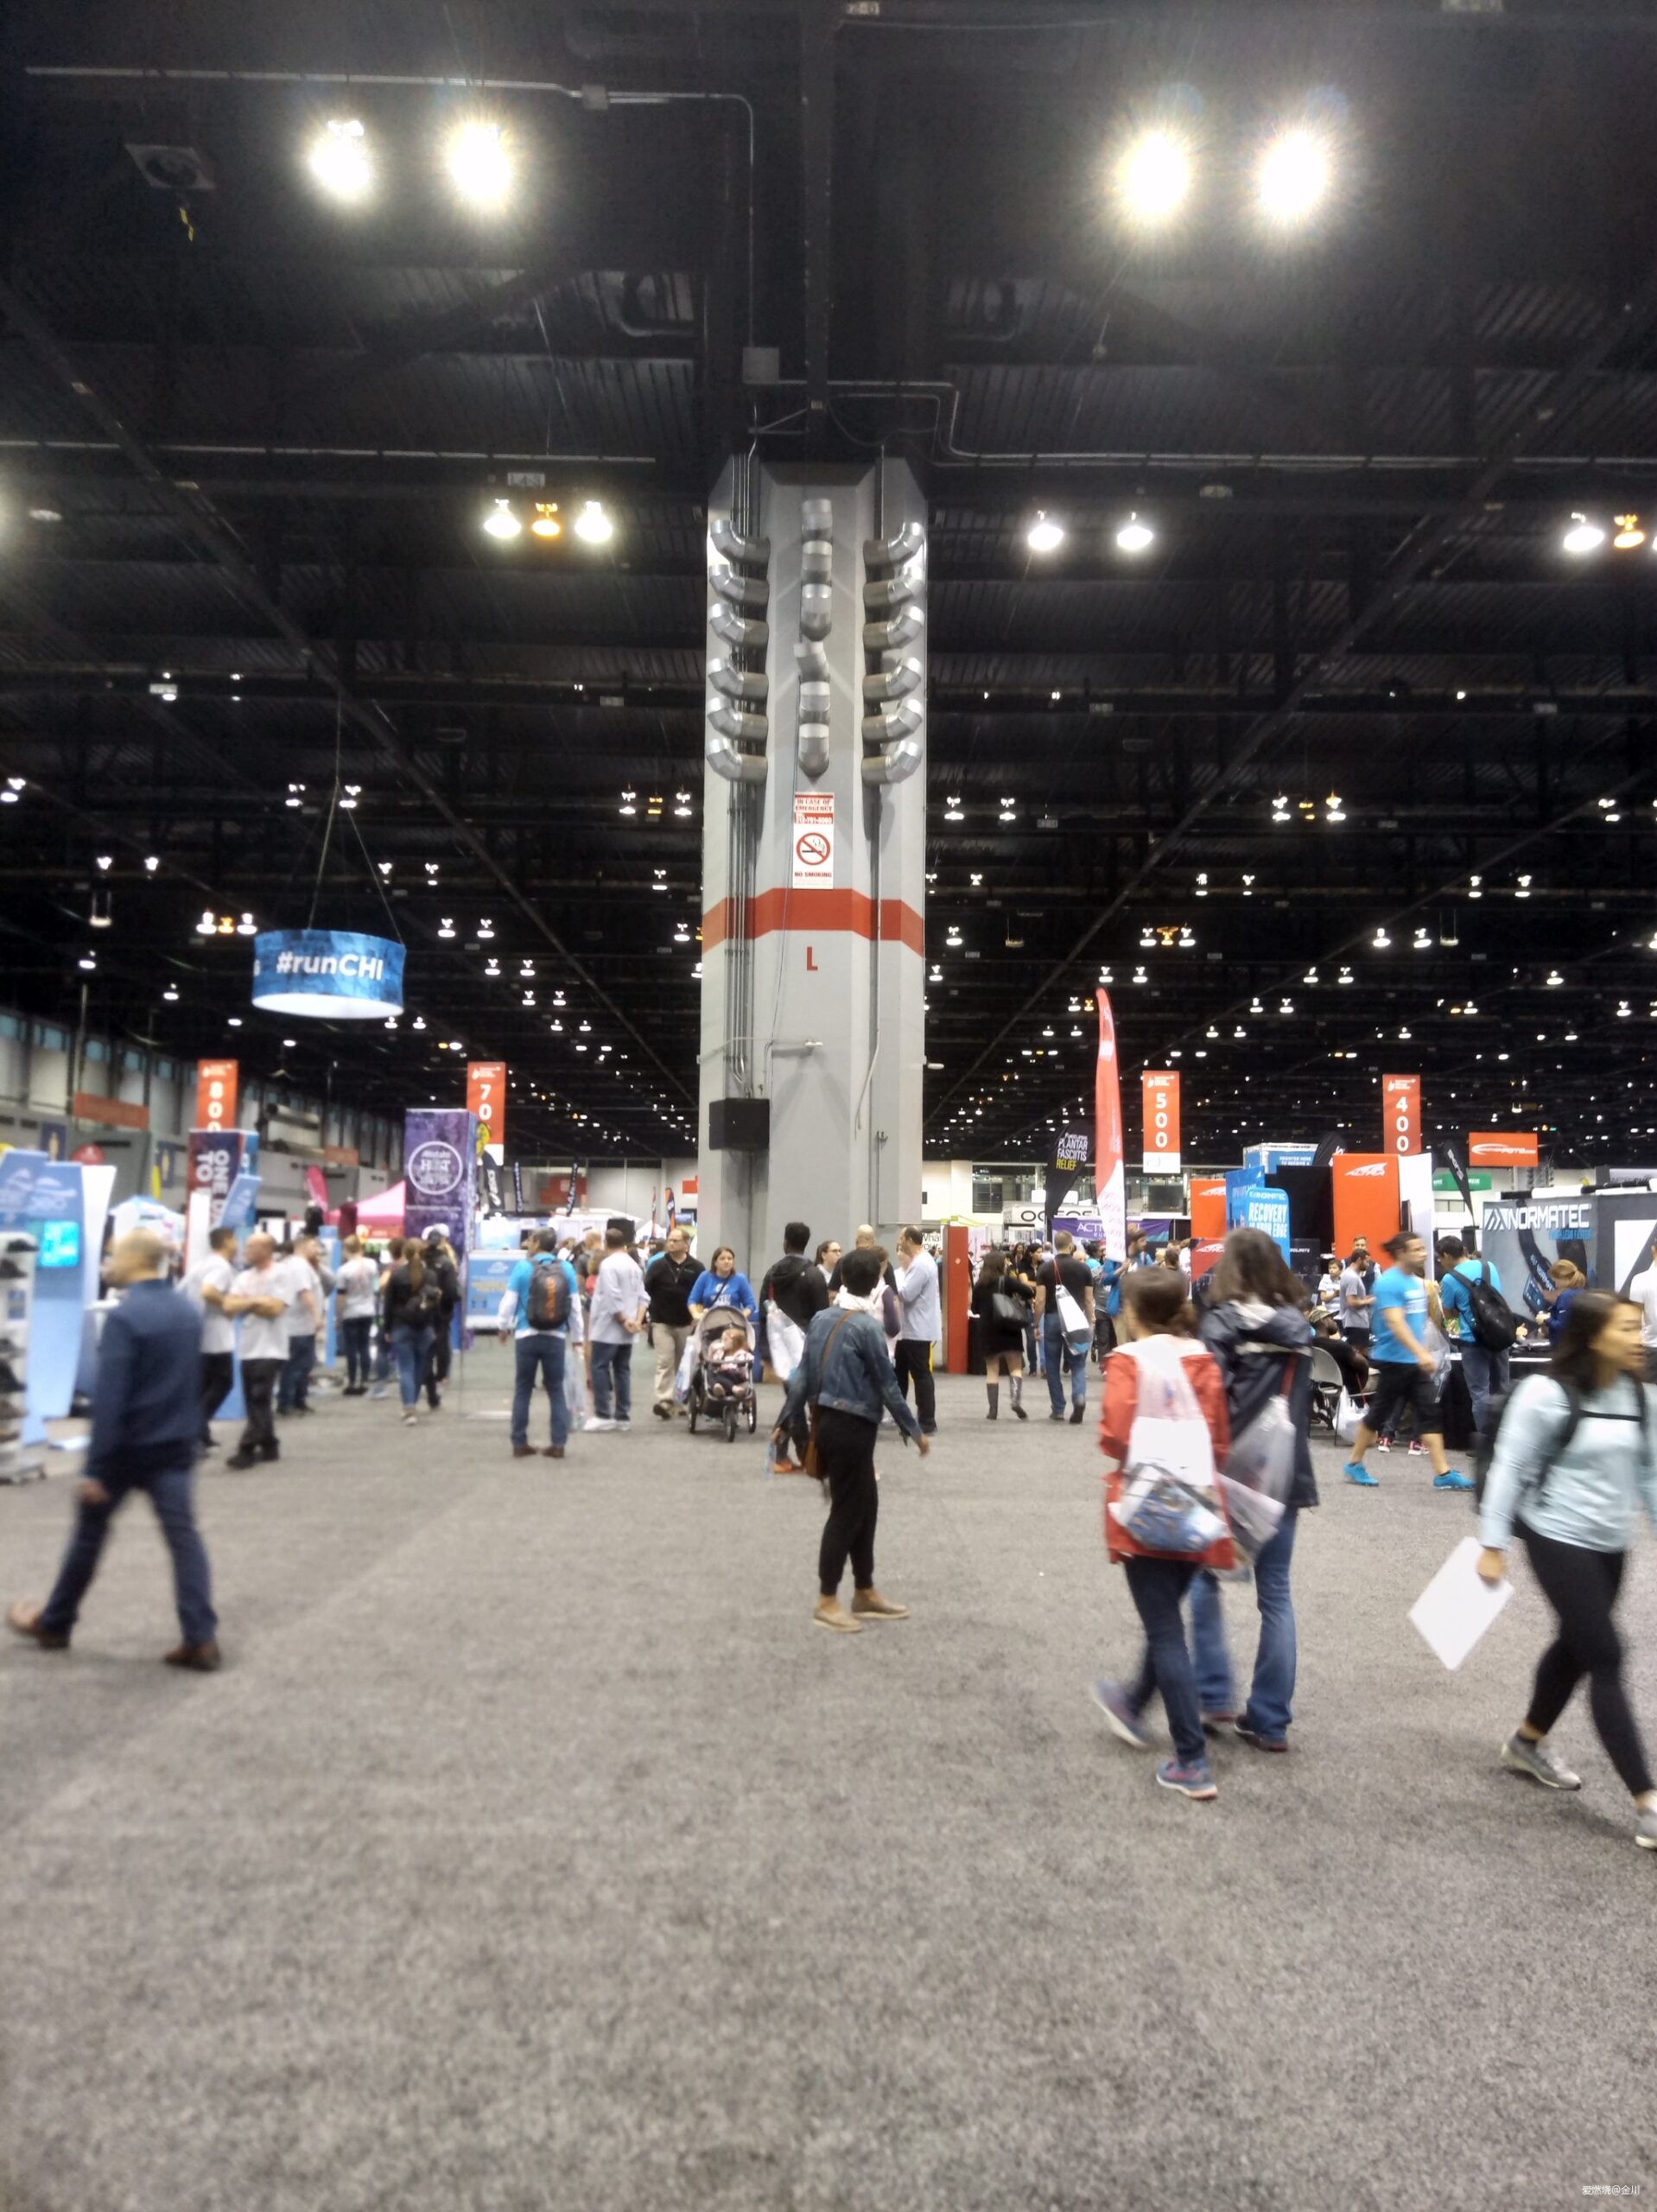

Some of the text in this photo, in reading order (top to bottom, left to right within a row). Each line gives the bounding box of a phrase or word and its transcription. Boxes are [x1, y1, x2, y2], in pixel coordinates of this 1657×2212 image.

[276, 950, 384, 981] #runCHI
[806, 946, 818, 970] L
[479, 1084, 492, 1129] 70
[1154, 1092, 1167, 1147] 500
[1396, 1096, 1409, 1152] 400
[1057, 1137, 1088, 1150] PLANTAR
[196, 1151, 213, 1182] TO
[213, 1149, 231, 1193] ONE
[1056, 1159, 1077, 1171] RELIEF
[1248, 1202, 1287, 1223] RECOVERY
[1508, 1204, 1590, 1230] NORMATEC
